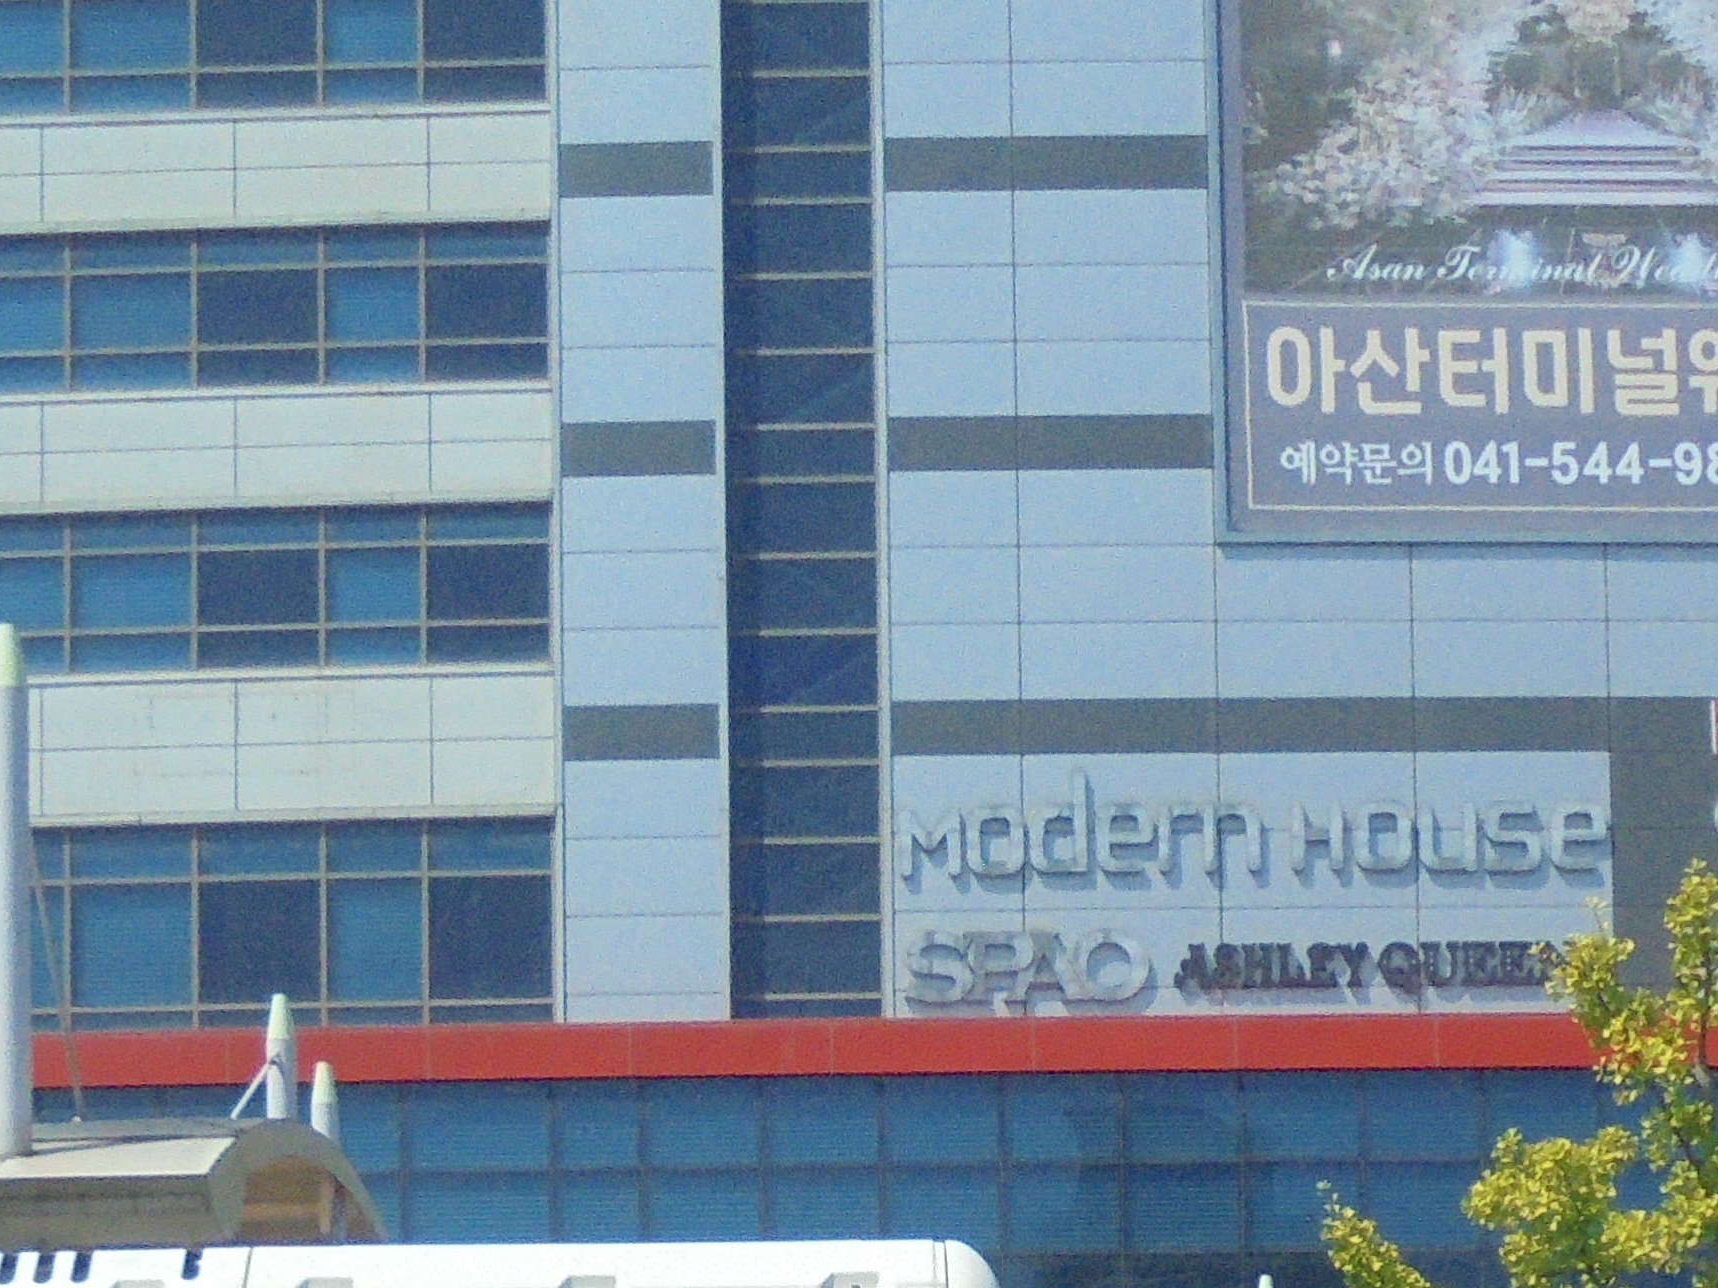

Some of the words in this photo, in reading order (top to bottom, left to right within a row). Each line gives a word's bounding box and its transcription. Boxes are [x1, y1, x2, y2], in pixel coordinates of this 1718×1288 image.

[1327, 244, 1425, 282] Asan
[1437, 245, 1609, 284] Terinal
[1280, 439, 1433, 485] 예약문의
[897, 766, 1263, 878] Modern
[1290, 800, 1611, 874] House
[905, 930, 1153, 1005] SPAO
[1174, 942, 1375, 990] ASHLEY
